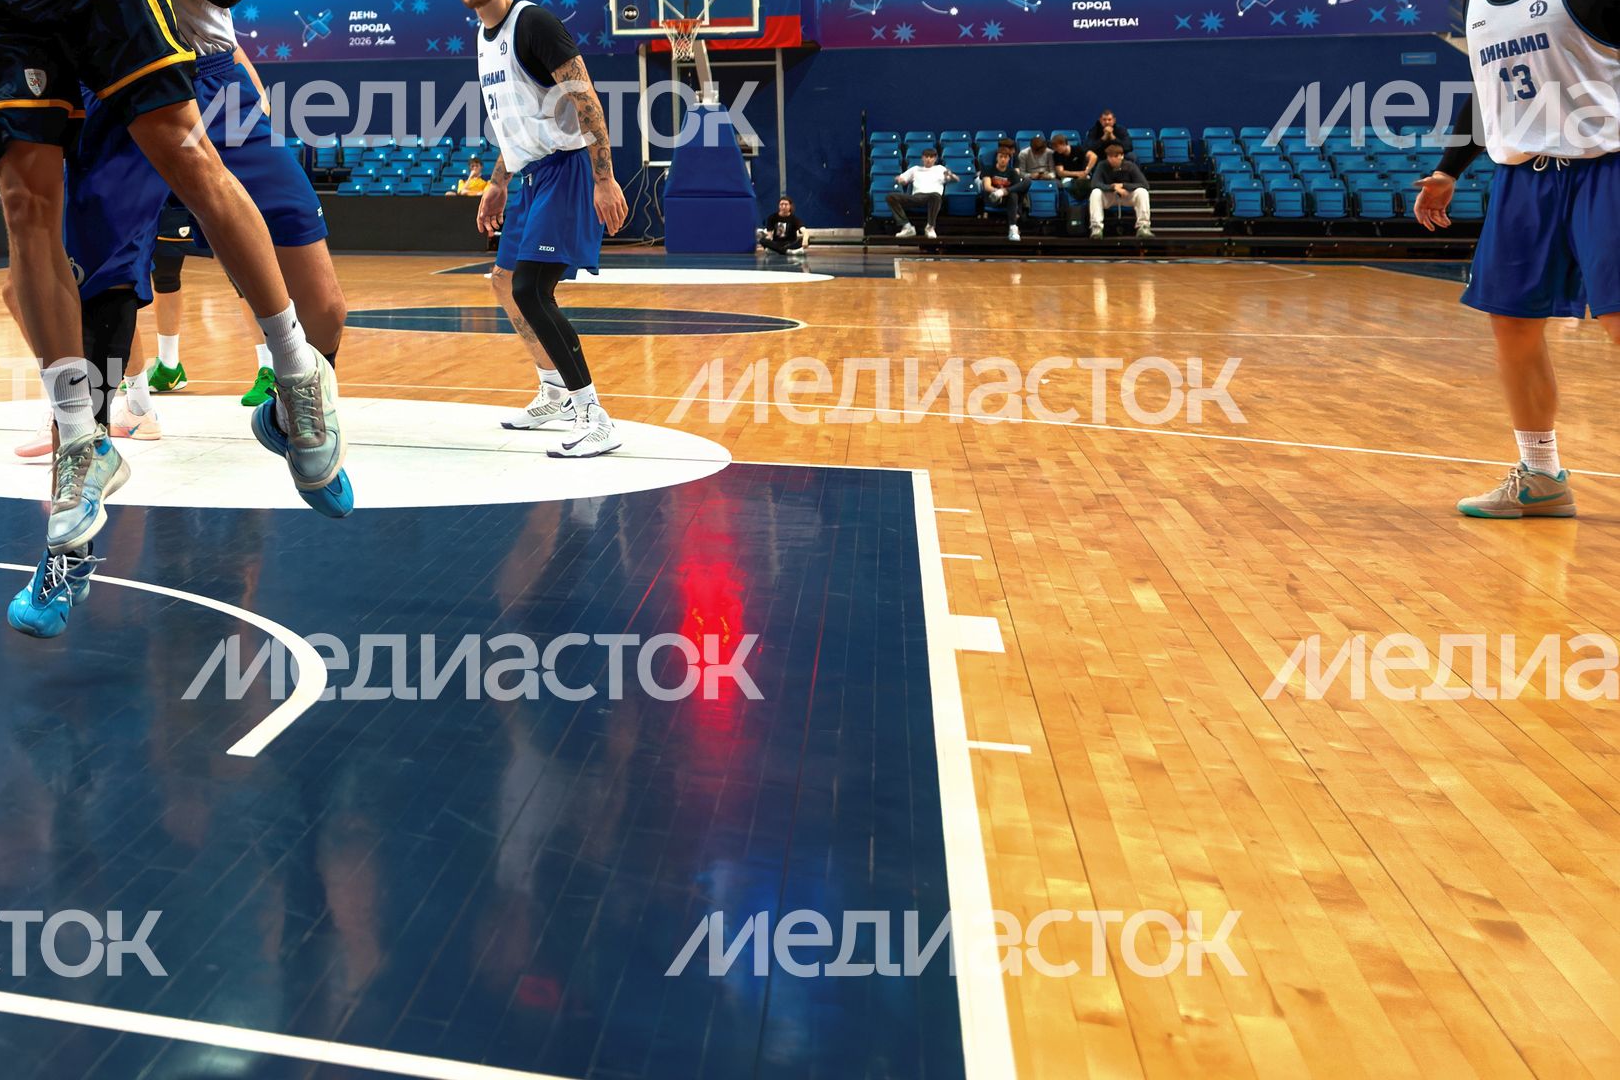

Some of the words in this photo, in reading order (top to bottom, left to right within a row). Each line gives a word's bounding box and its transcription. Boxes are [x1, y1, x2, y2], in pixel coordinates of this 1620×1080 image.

[1072, 0, 1112, 11] ГОРОД
[348, 10, 378, 21] ДЕНЬ
[348, 23, 392, 33] ГОРОДА
[1073, 17, 1139, 29] ЕДИНСТВА!
[349, 36, 372, 46] 2026
[1479, 32, 1550, 67] ДИНАМО
[1498, 64, 1537, 103] 13
[538, 245, 555, 253] ZEDO
